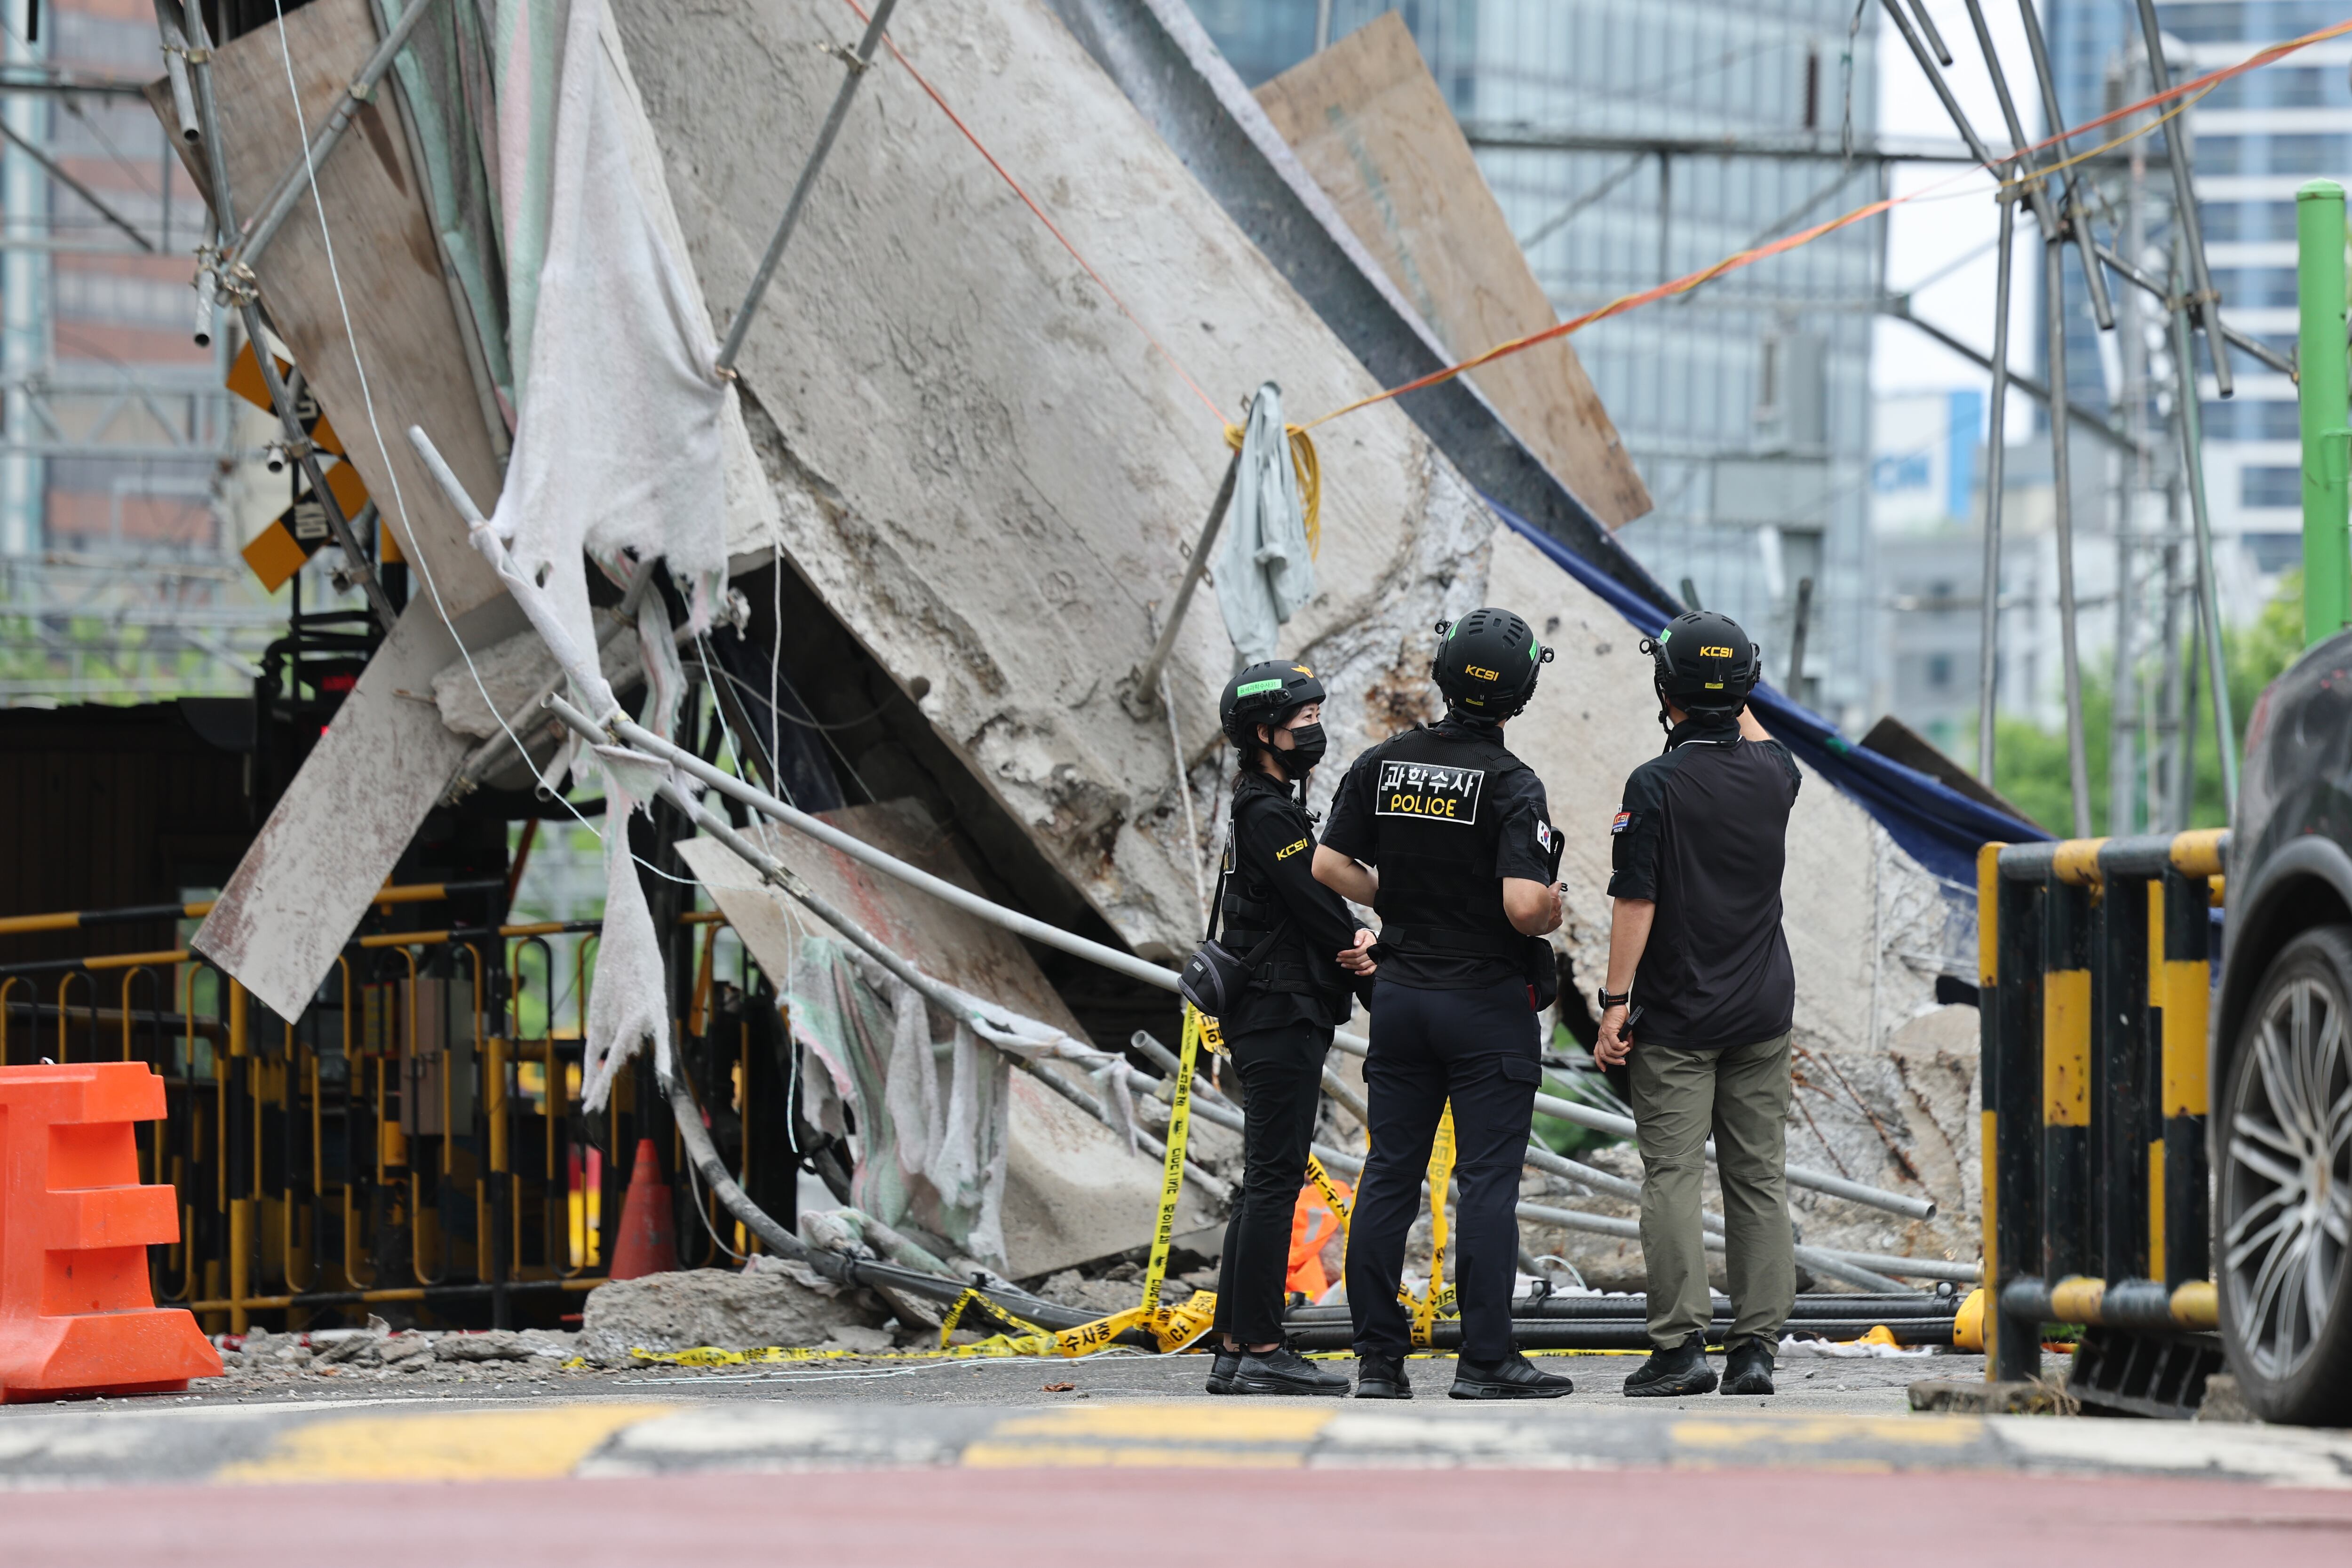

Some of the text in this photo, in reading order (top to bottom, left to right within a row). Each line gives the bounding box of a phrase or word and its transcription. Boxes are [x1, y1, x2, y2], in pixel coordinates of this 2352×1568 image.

[1700, 646, 1733, 658] KCSI
[1465, 664, 1500, 682] KCSI
[1384, 766, 1474, 797] 과학수사
[1391, 794, 1457, 817] POLICE
[1613, 814, 1629, 825] KCSI
[1276, 838, 1308, 861] KCSI
